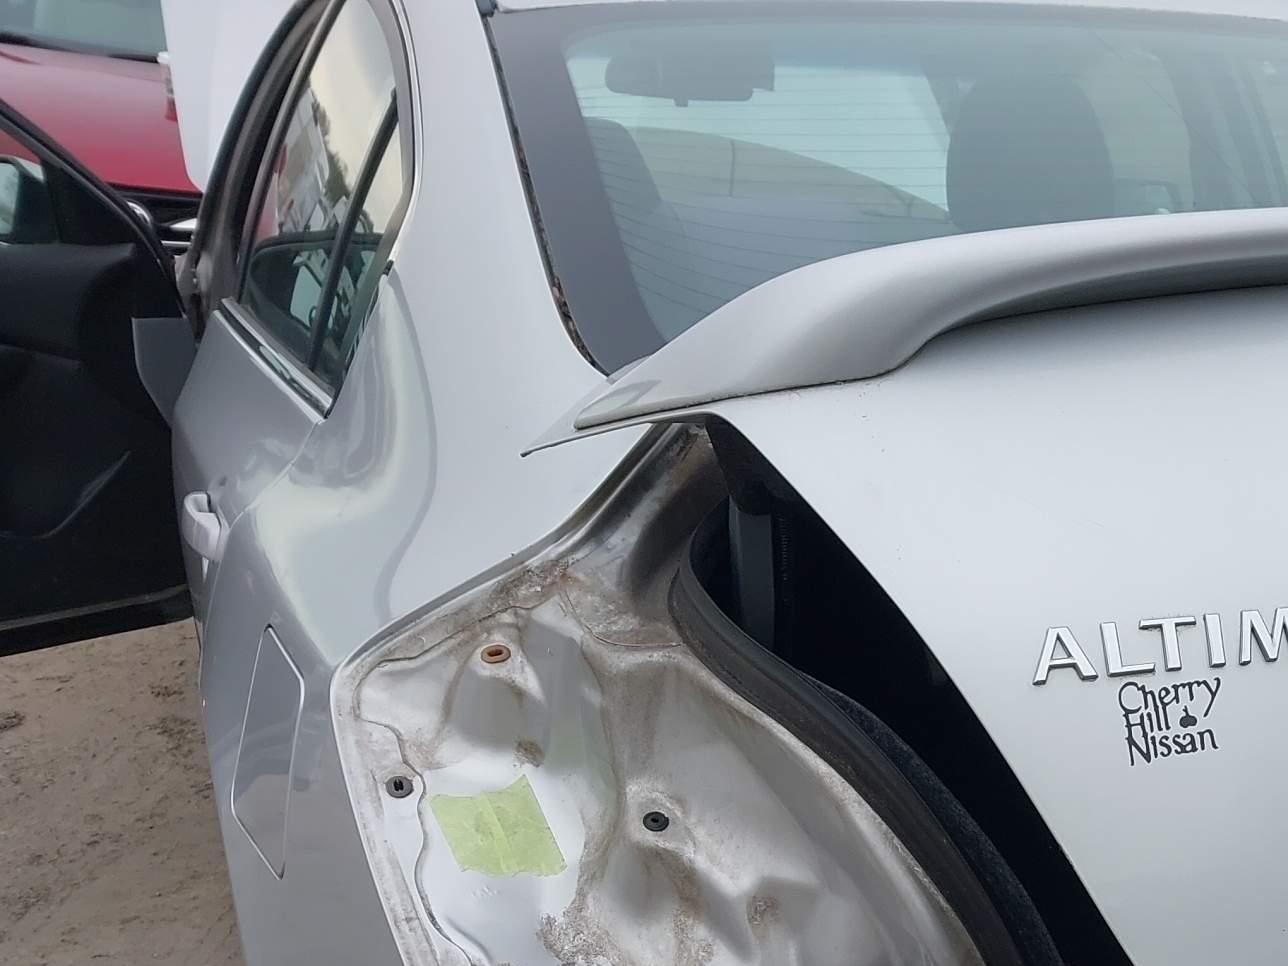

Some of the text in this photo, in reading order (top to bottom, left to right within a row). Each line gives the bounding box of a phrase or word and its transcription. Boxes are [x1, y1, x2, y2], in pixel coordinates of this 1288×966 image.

[1118, 677, 1221, 717] Cherry
[1123, 706, 1172, 734] Hill
[1125, 727, 1218, 766] Nissan
